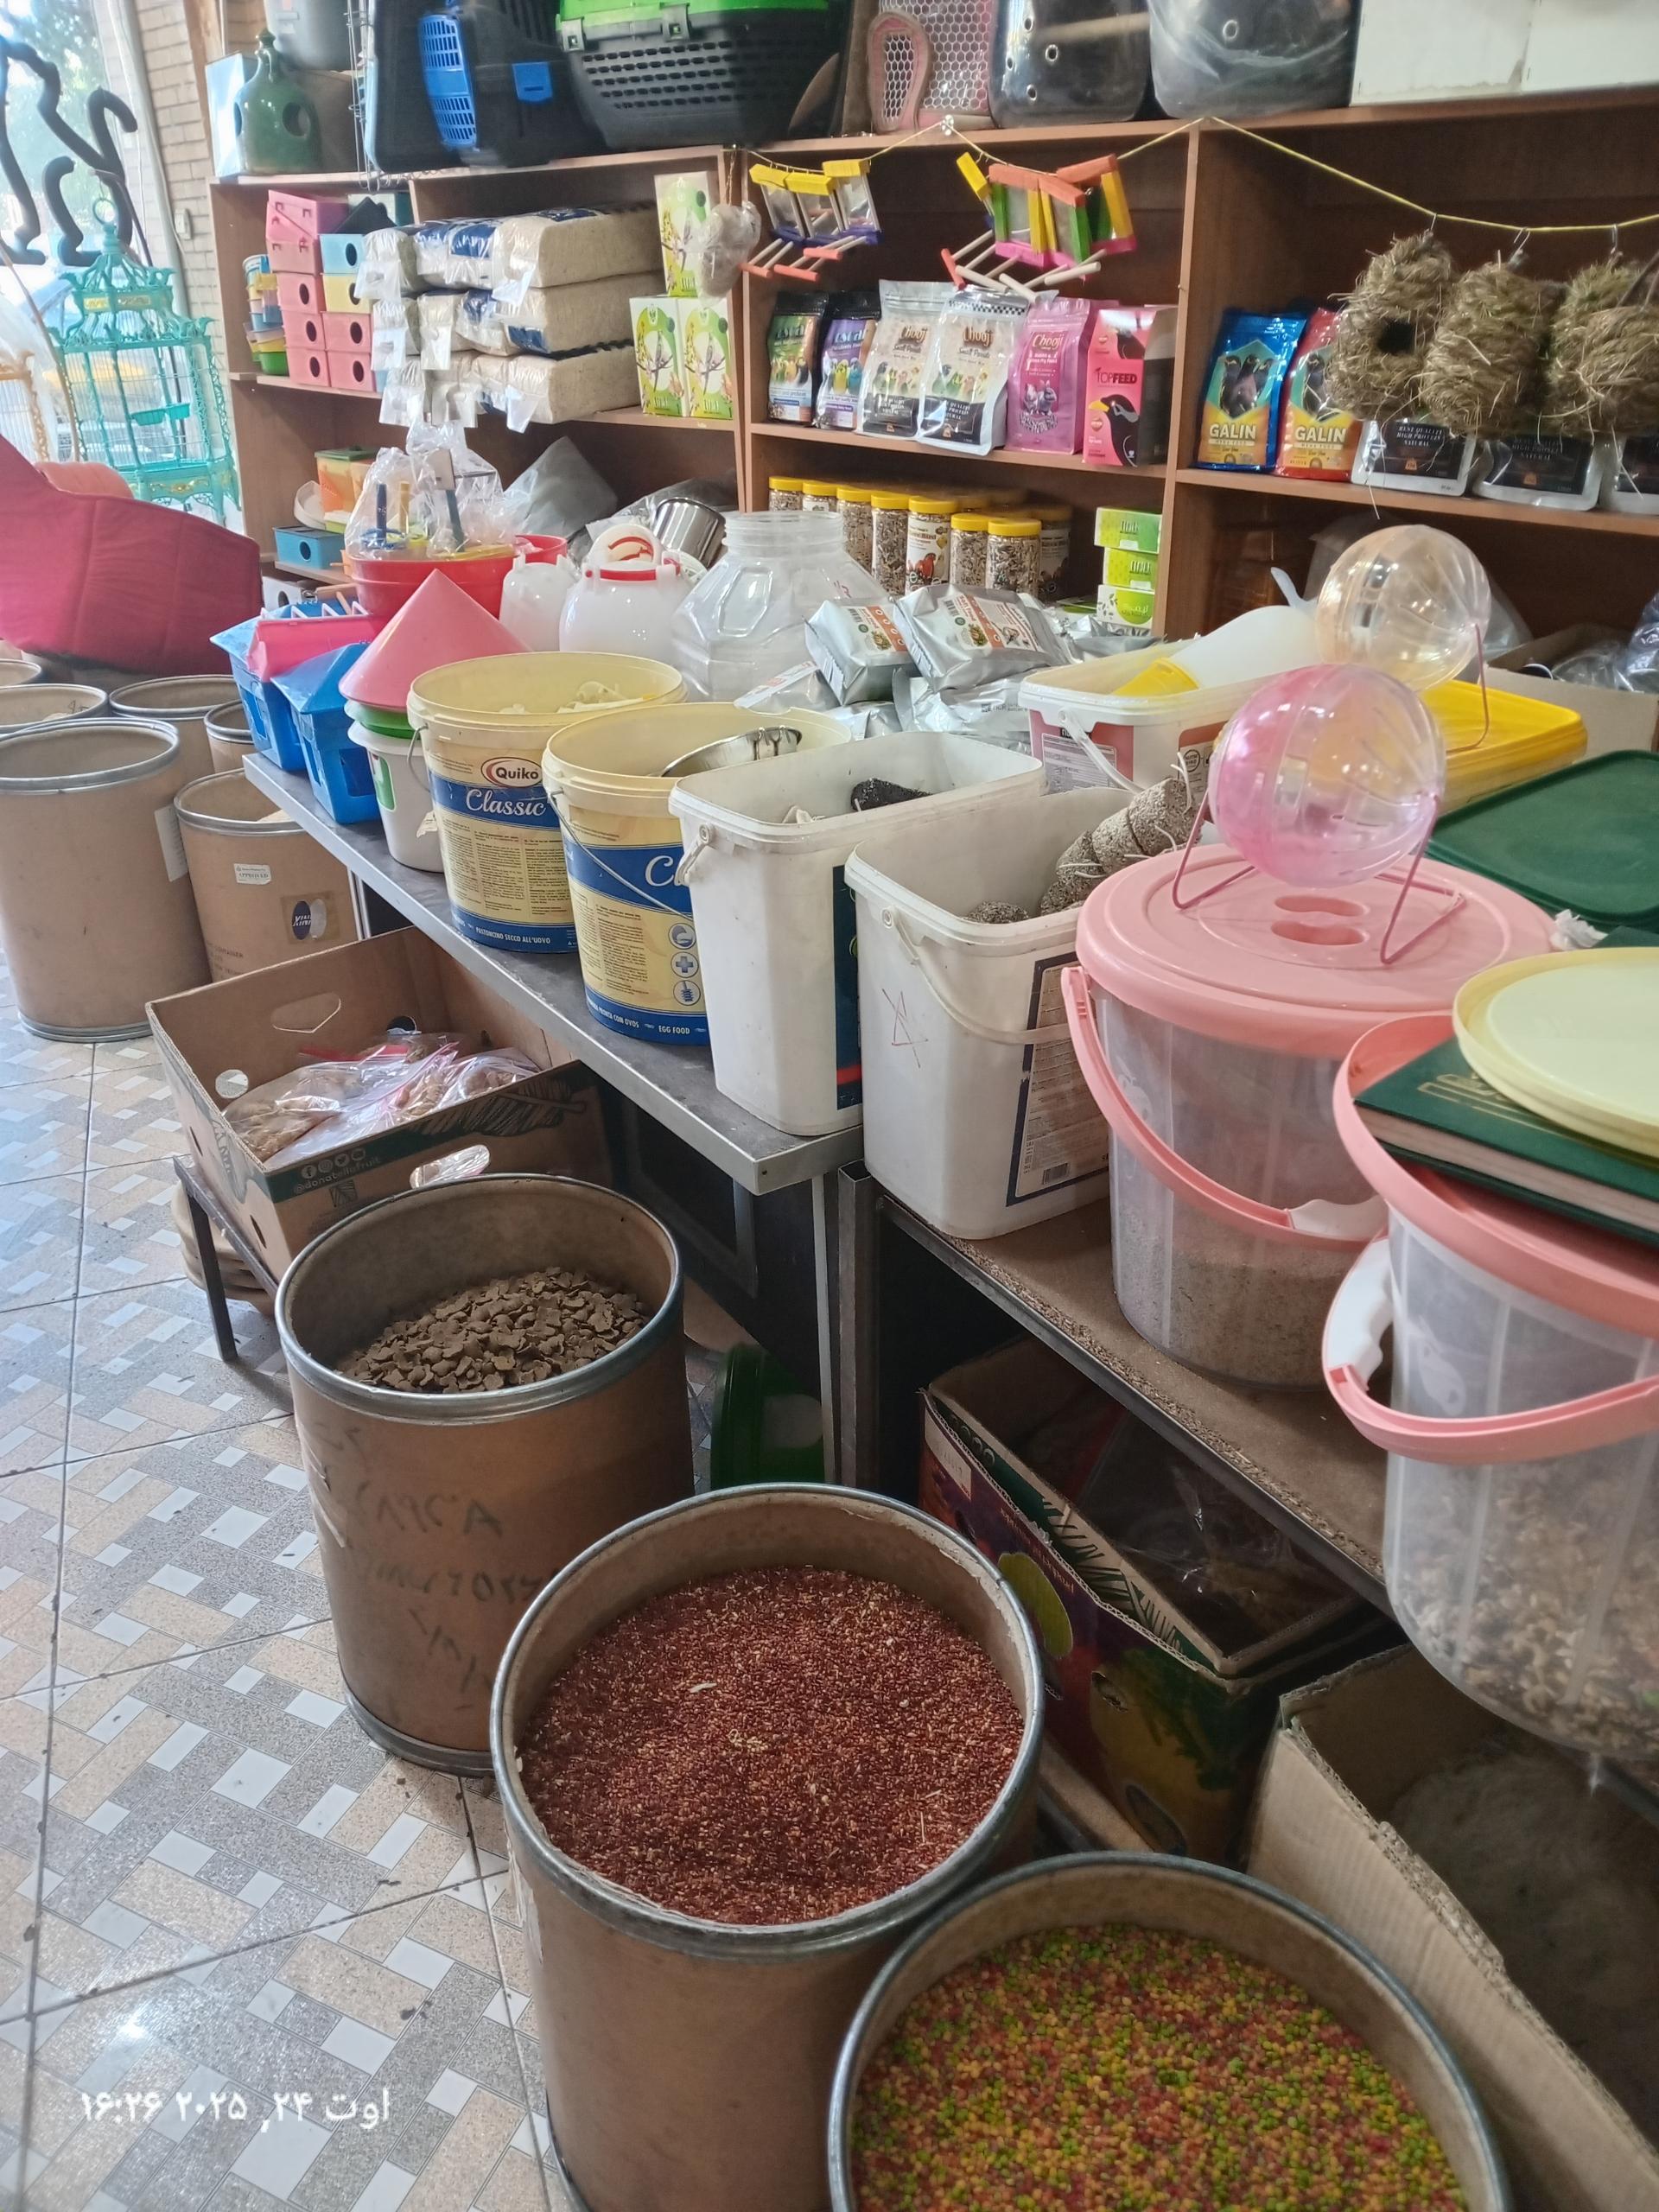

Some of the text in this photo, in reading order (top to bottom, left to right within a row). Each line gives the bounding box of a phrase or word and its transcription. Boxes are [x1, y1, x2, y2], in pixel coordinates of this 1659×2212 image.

[1095, 367, 1137, 385] TOPFEED
[1210, 423, 1256, 439] GALIN
[1295, 426, 1347, 443] GALIN
[1414, 433, 1442, 442] PROTEIN
[496, 766, 539, 780] Quiko
[466, 789, 546, 817] Classic
[476, 927, 550, 944] PASTONCINO SECCO ALL'UOVO
[625, 1018, 639, 1028] OVOS
[658, 1025, 690, 1034] EGG FOOD
